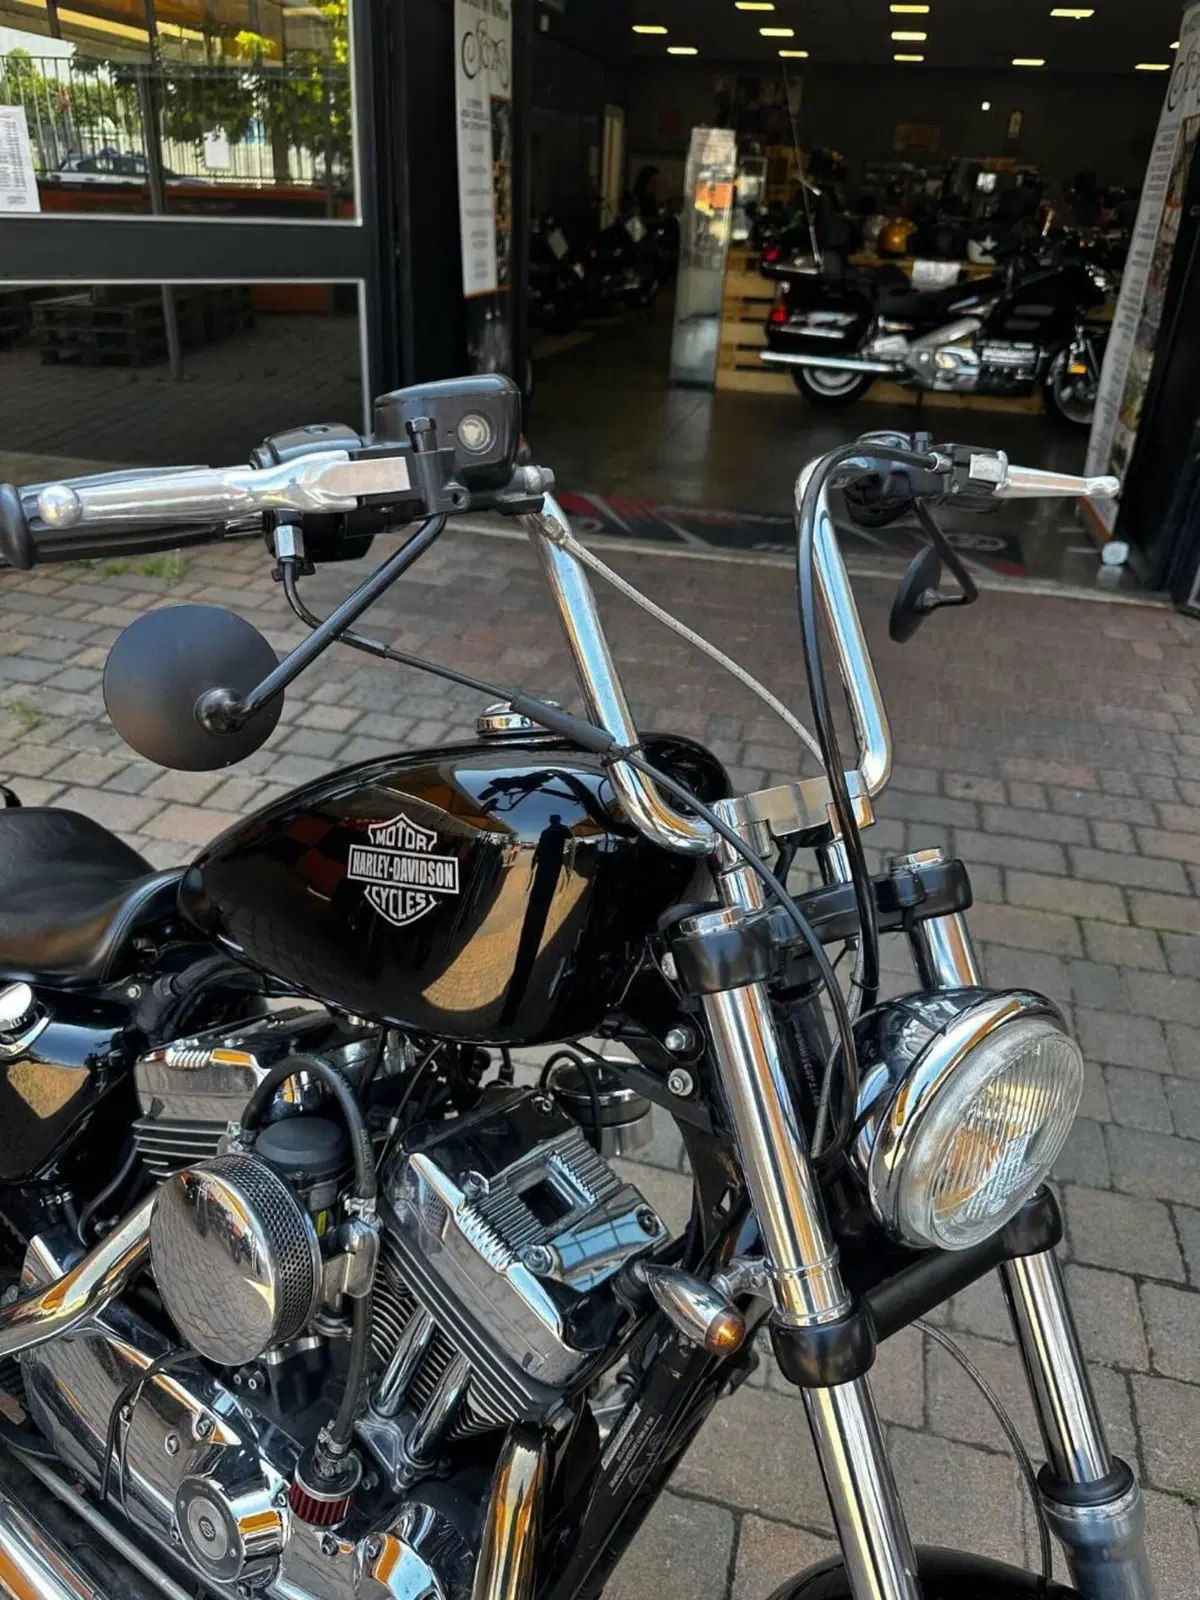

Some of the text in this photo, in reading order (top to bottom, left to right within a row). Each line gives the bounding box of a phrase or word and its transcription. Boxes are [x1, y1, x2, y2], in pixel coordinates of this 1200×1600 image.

[375, 820, 428, 851] MOTOR
[352, 850, 454, 888] HARLEY-DAVIDSON
[371, 886, 427, 920] CYCLES
